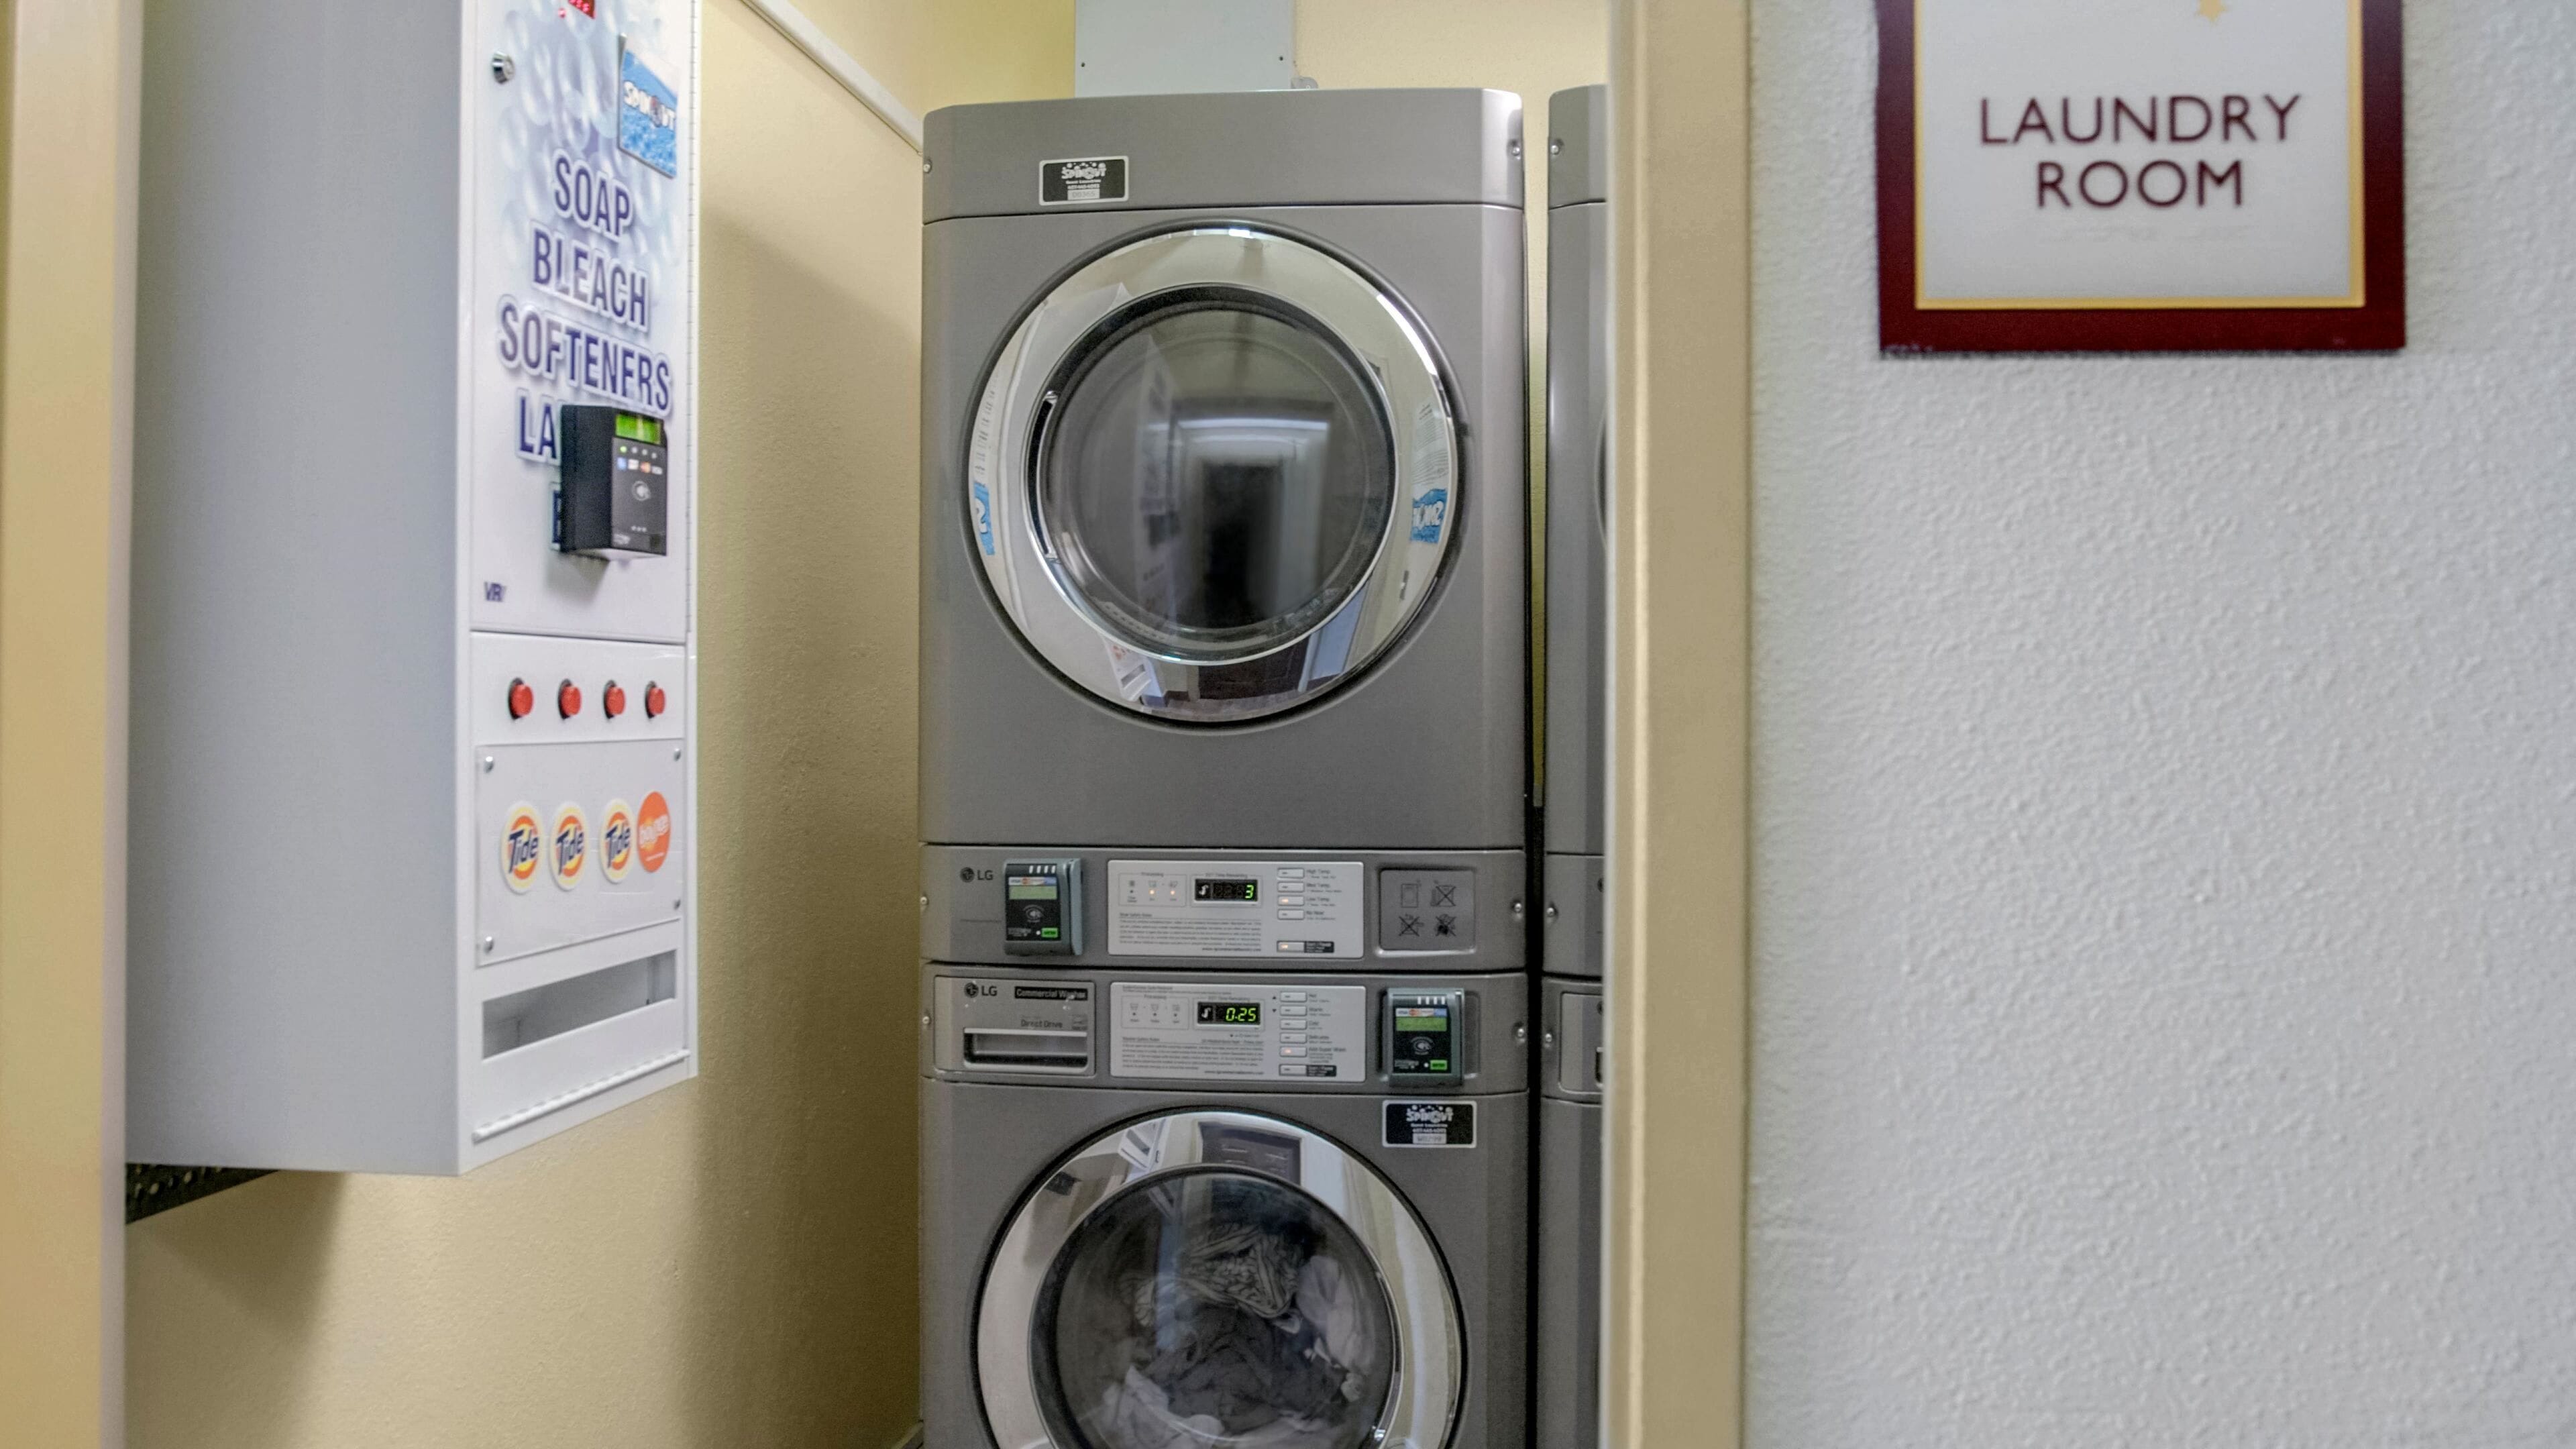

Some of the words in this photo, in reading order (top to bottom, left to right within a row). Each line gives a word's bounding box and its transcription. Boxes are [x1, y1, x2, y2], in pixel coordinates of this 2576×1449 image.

[1980, 94, 2301, 146] LAUNDRY
[554, 157, 630, 236] SOAP
[2036, 159, 2243, 209] ROOM
[533, 229, 646, 326] BLEACH
[508, 828, 539, 873] Tide
[556, 827, 584, 875] Tide
[606, 822, 631, 869] Tide
[977, 869, 994, 881] LG
[1244, 884, 1254, 899] 3
[981, 985, 998, 997] LG
[1044, 1020, 1063, 1028] Drive
